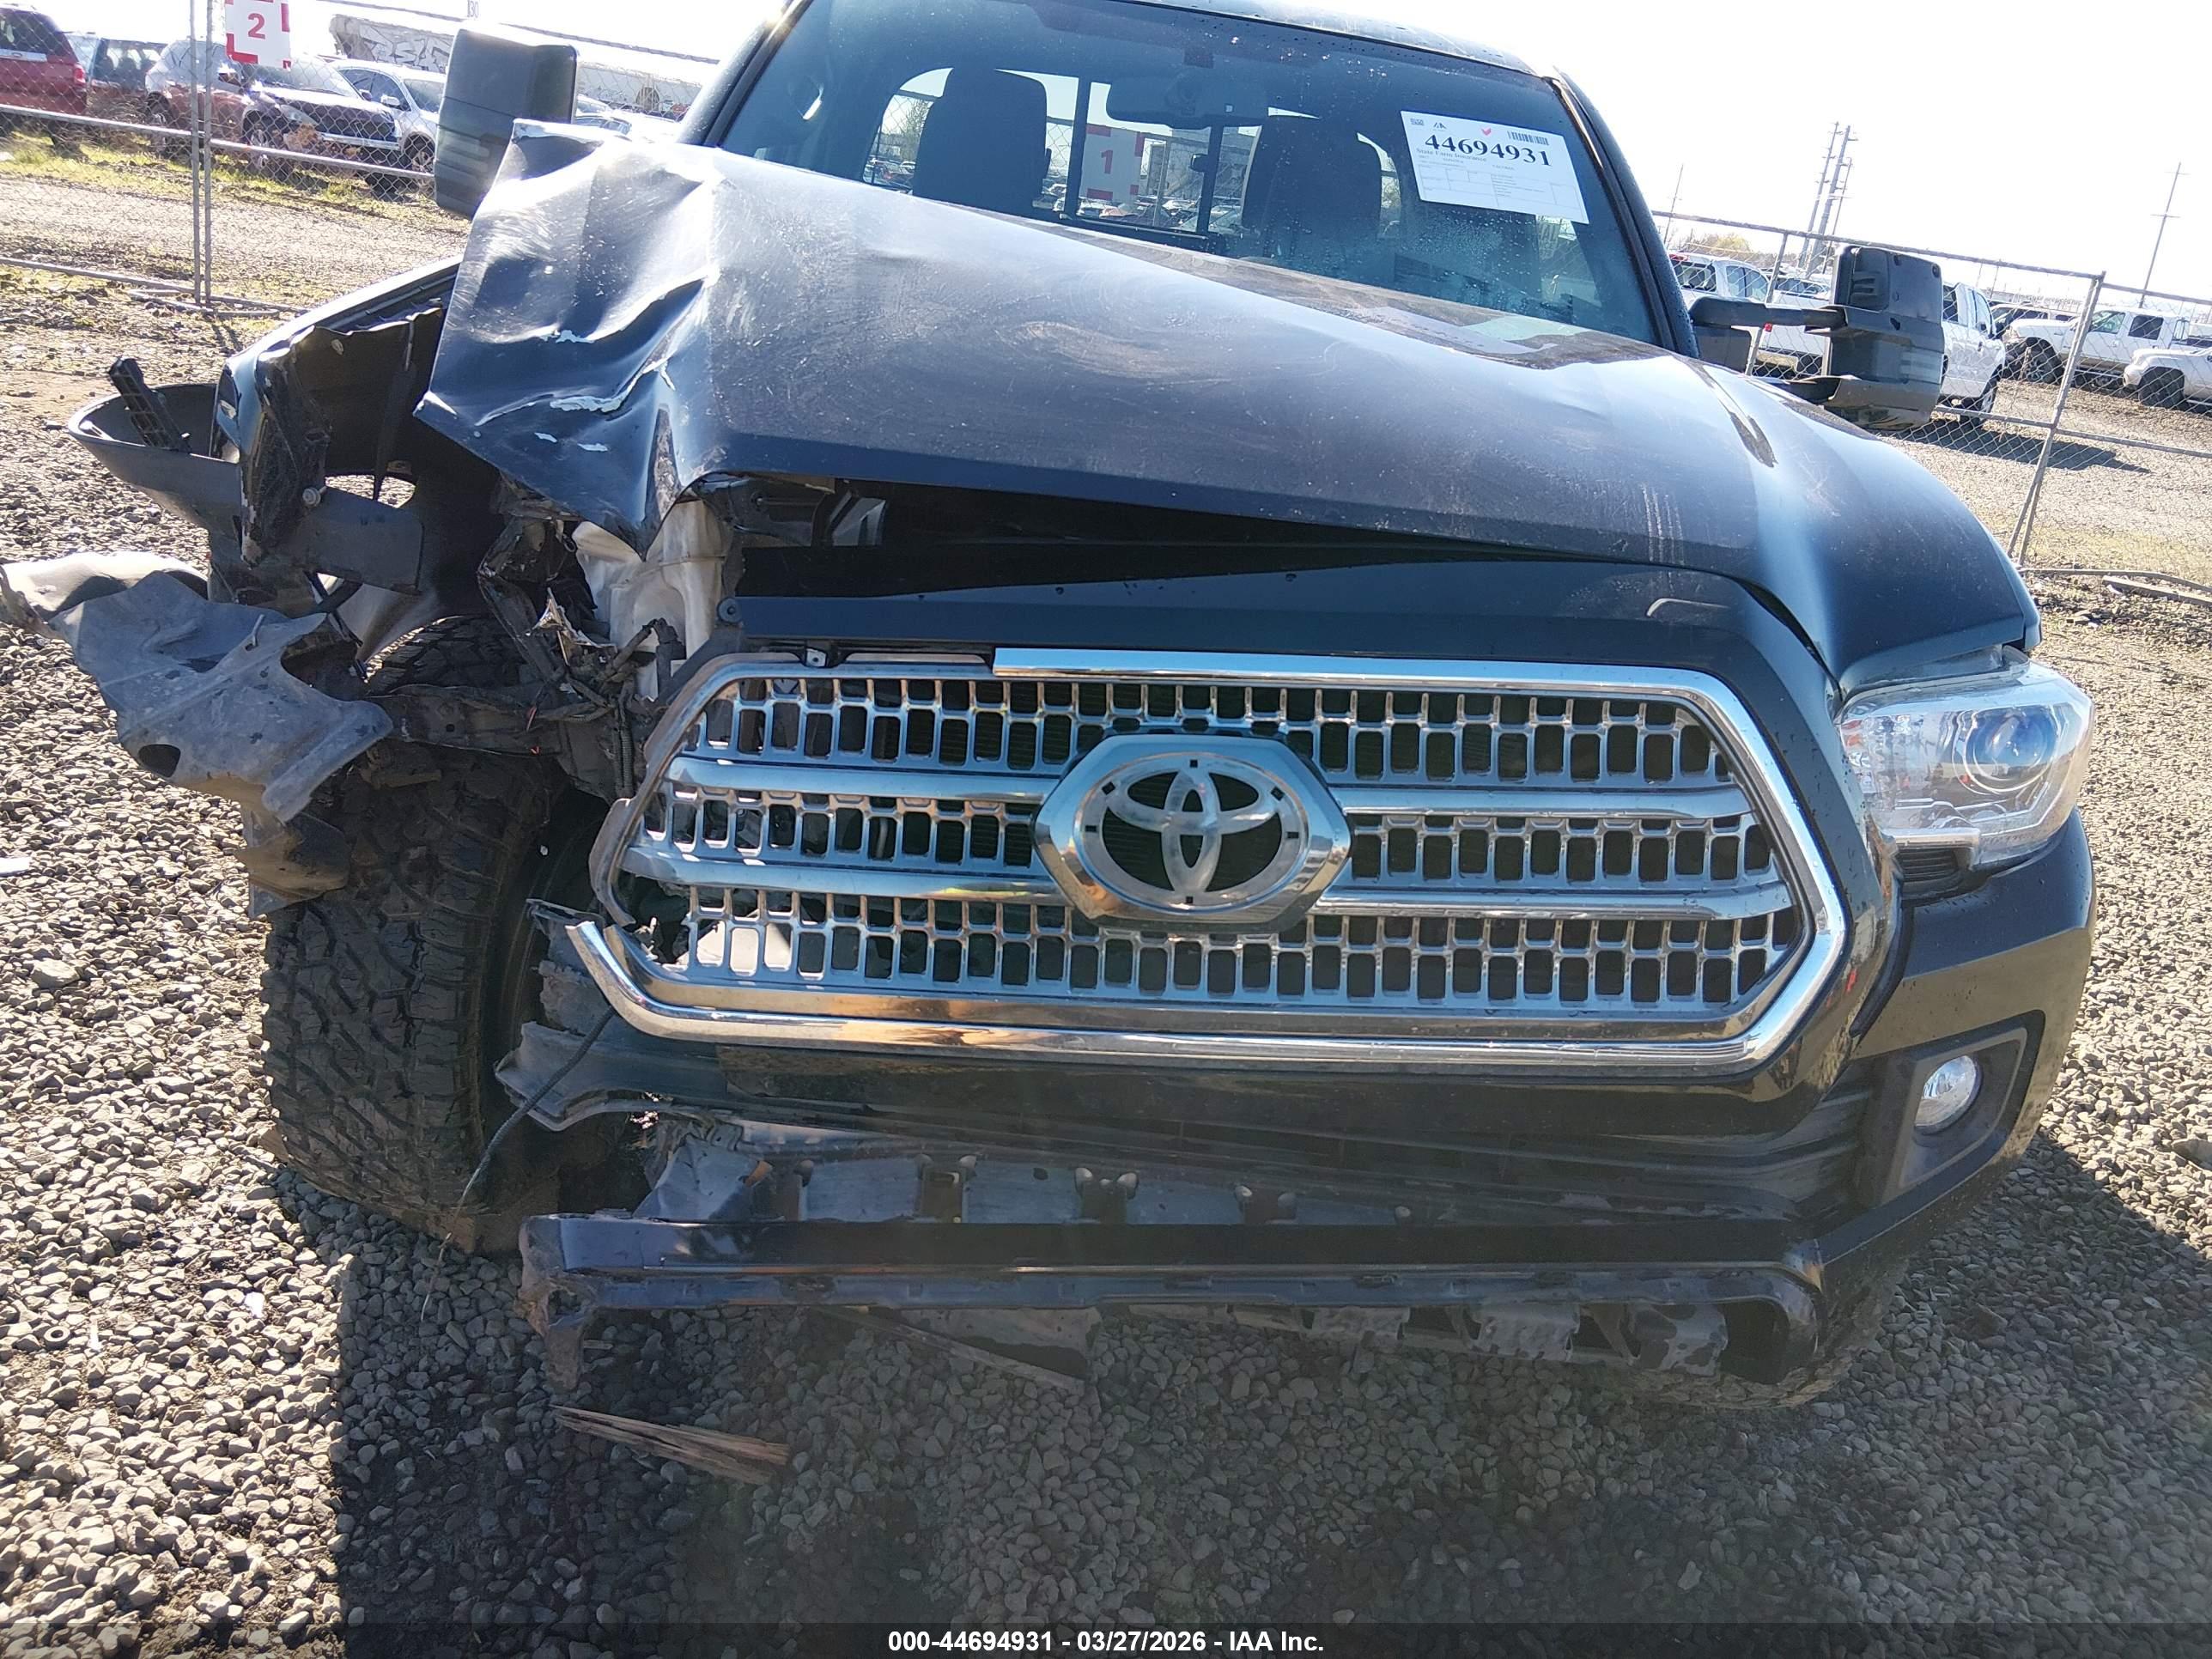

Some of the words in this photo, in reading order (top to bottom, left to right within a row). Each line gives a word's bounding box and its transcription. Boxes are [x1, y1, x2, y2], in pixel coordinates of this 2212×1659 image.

[248, 13, 265, 40] 2
[1101, 149, 1113, 174] 1
[1425, 135, 1553, 167] 44694931
